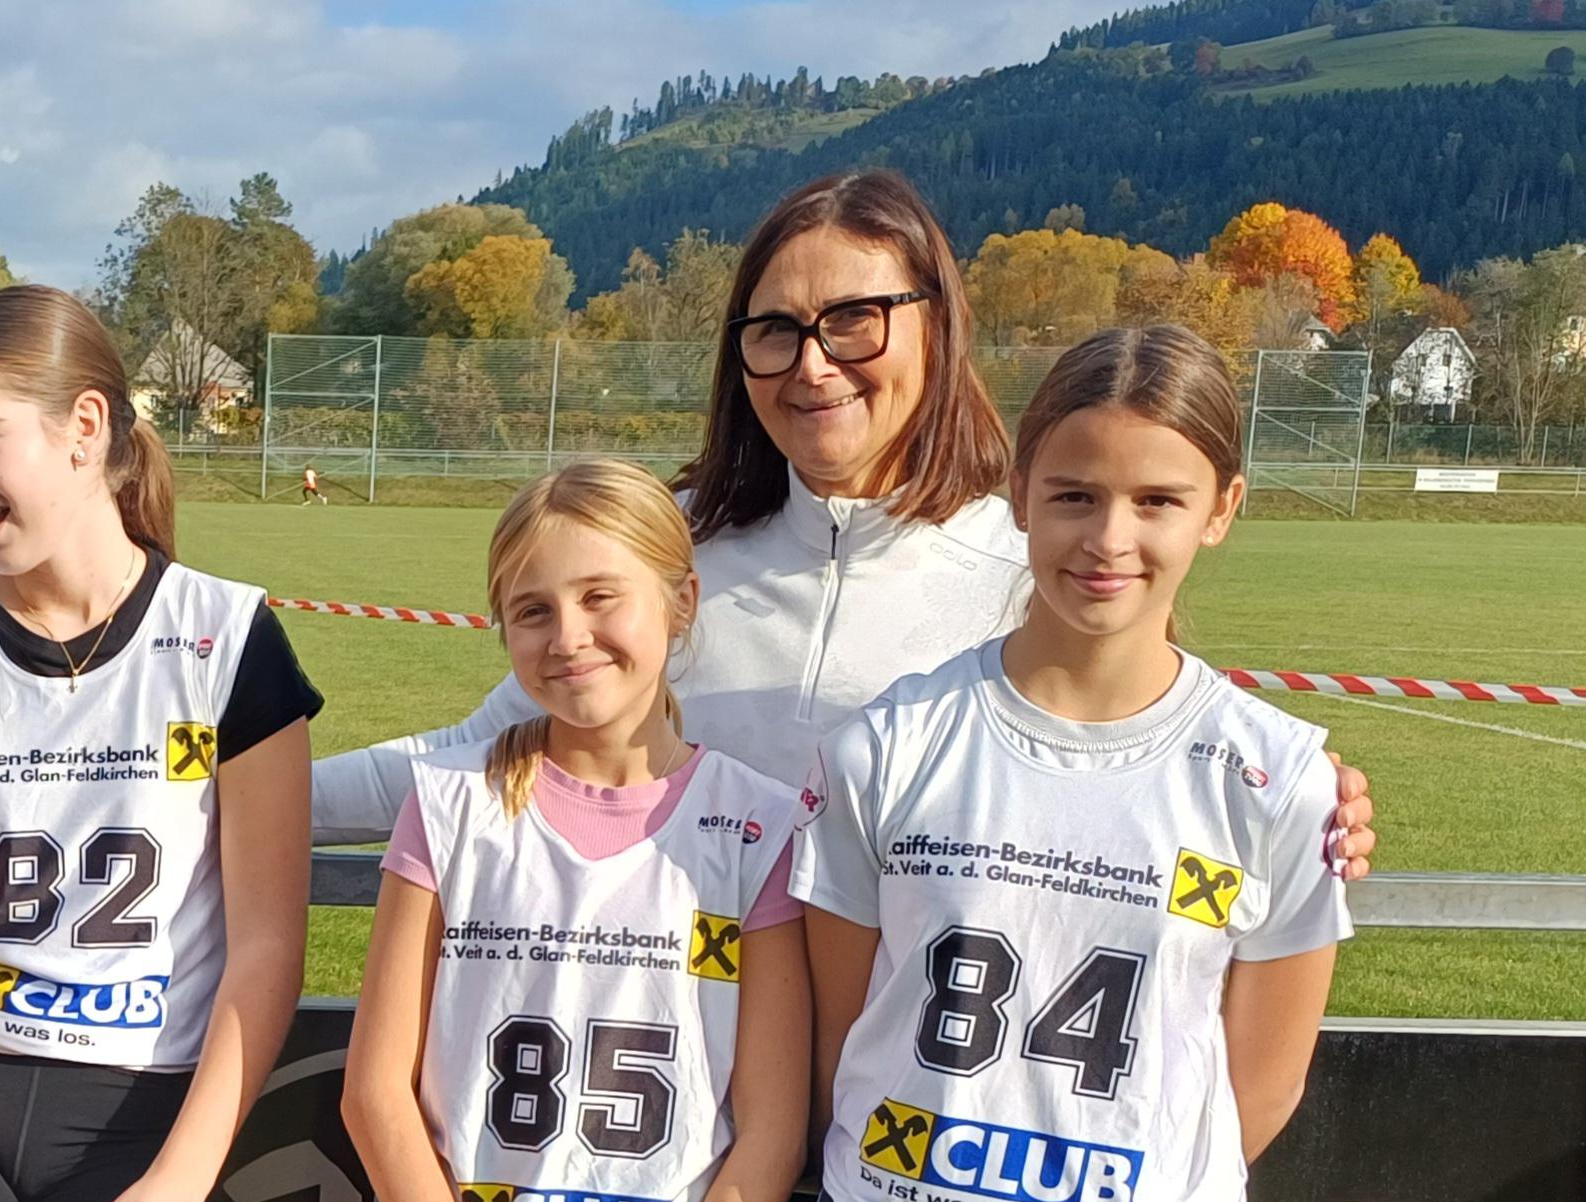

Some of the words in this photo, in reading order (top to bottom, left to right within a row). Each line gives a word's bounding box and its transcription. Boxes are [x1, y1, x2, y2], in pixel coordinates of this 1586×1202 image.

[0, 769, 14, 784] d.
[20, 765, 159, 783] Glan-Feldkirchen
[888, 834, 1164, 888] aiffeisen-Bezirksbank
[961, 861, 979, 879] d.
[986, 864, 1159, 908] Glan-Feldkirchen
[506, 945, 523, 960] d.
[529, 945, 680, 971] Glan-Feldkirchen
[10, 979, 165, 1024] CLUB
[914, 925, 1146, 1101] 84
[4, 1021, 50, 1041] was
[58, 1028, 96, 1046] los.
[485, 1014, 679, 1160] 85
[860, 1165, 882, 1190] Da
[888, 1179, 919, 1202] ist
